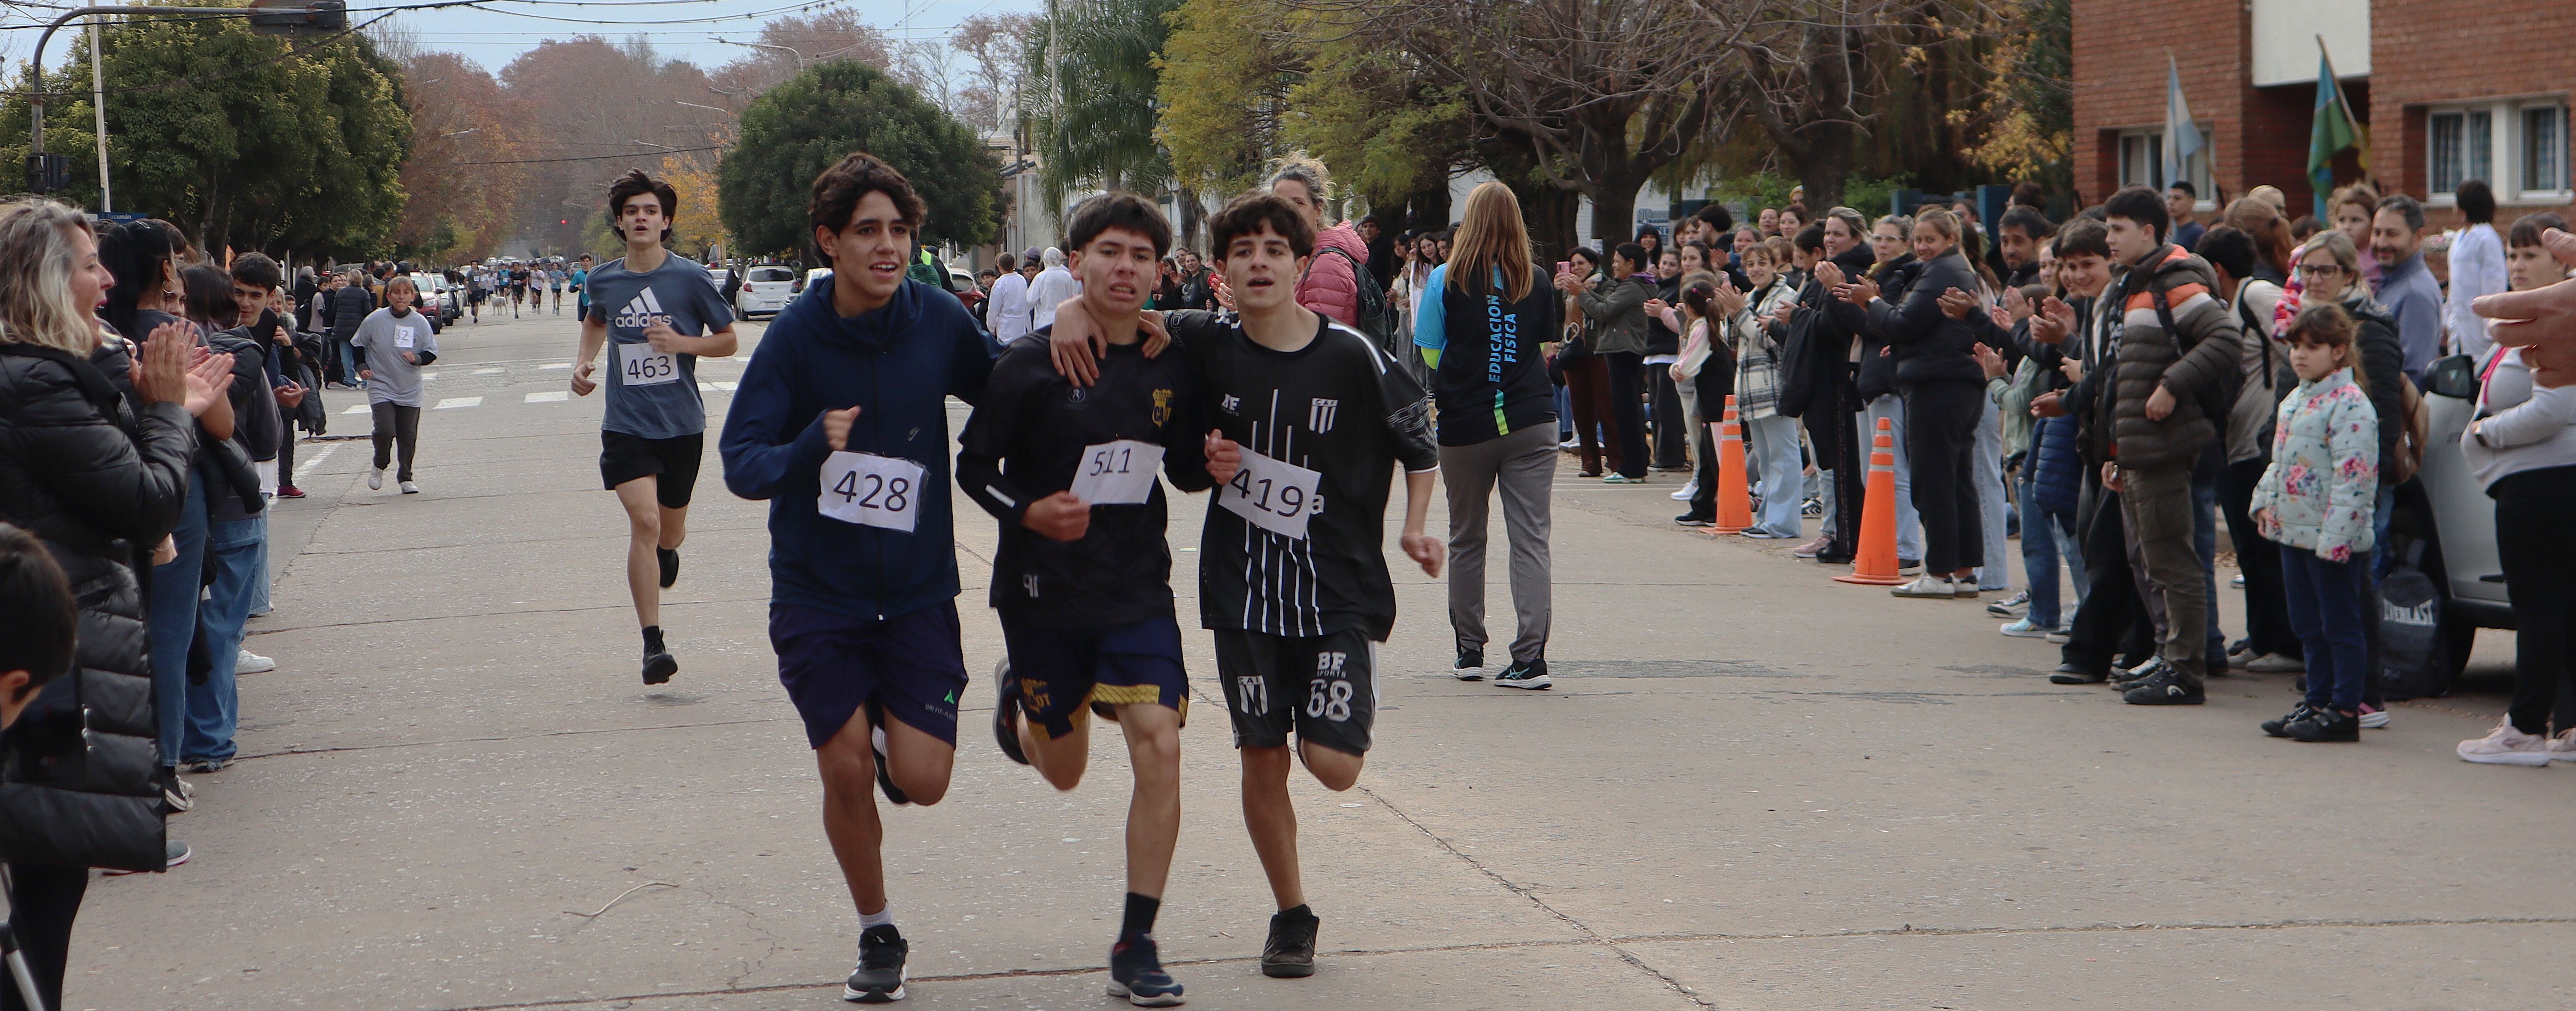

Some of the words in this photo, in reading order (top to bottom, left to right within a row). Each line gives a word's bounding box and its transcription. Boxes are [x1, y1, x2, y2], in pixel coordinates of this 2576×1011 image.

[1486, 294, 1502, 383] EDUCACION
[1504, 314, 1516, 363] FISICA
[627, 356, 671, 379] 463
[1090, 448, 1130, 476] 511
[833, 470, 908, 512] 428
[1230, 469, 1303, 517] 419
[1317, 651, 1347, 671] BF
[1306, 679, 1353, 722] 68
